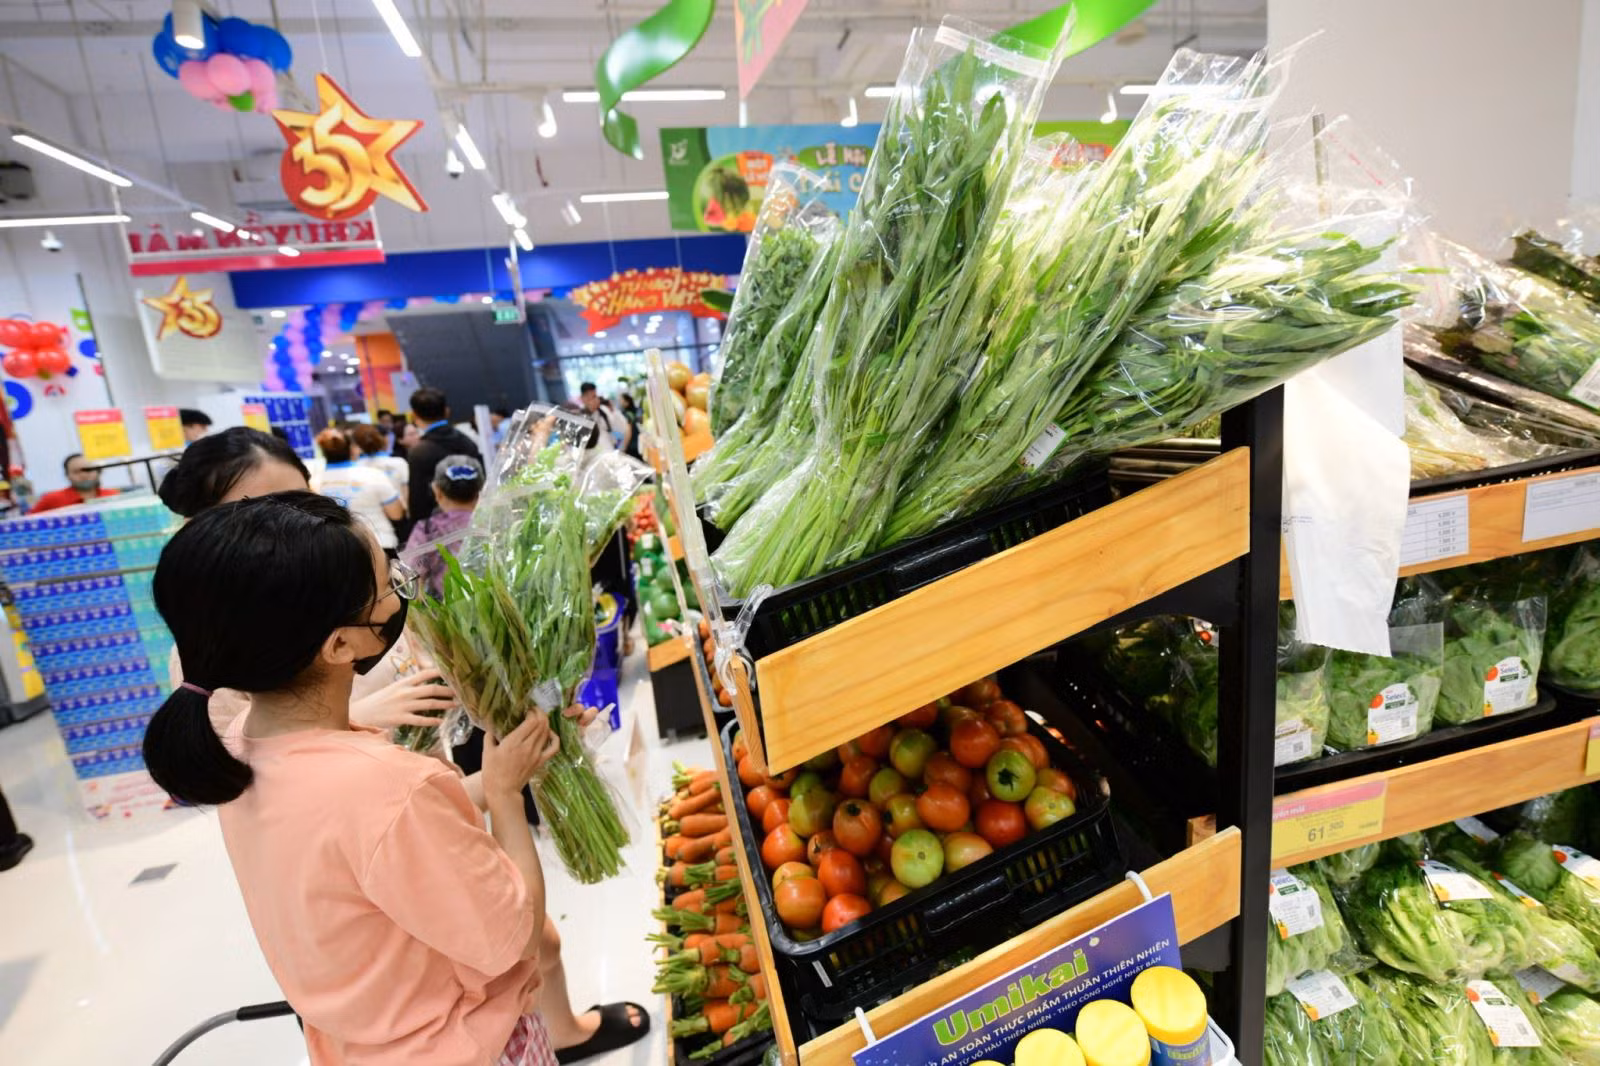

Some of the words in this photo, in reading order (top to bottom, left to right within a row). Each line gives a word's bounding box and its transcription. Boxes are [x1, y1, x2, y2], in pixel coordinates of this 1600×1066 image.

[291, 103, 372, 212] 35
[1308, 826, 1325, 842] 61
[932, 948, 1089, 1046] Umikai
[941, 1052, 958, 1066] AN
[959, 1033, 992, 1056] TOÀN
[993, 1015, 1026, 1038] THỰC
[1027, 996, 1061, 1019] PHẨM
[1062, 976, 1101, 1000] THUẦN
[1102, 958, 1135, 979] THIÊN
[1136, 939, 1170, 962] NHIÊN
[1003, 1028, 1026, 1043] THIÊN
[1027, 1015, 1052, 1030] NHIÊN
[1057, 1000, 1078, 1013] THEO
[1079, 987, 1101, 1003] CÔNG
[1102, 976, 1123, 991] NGHỆ
[1124, 964, 1145, 979] NHẤT
